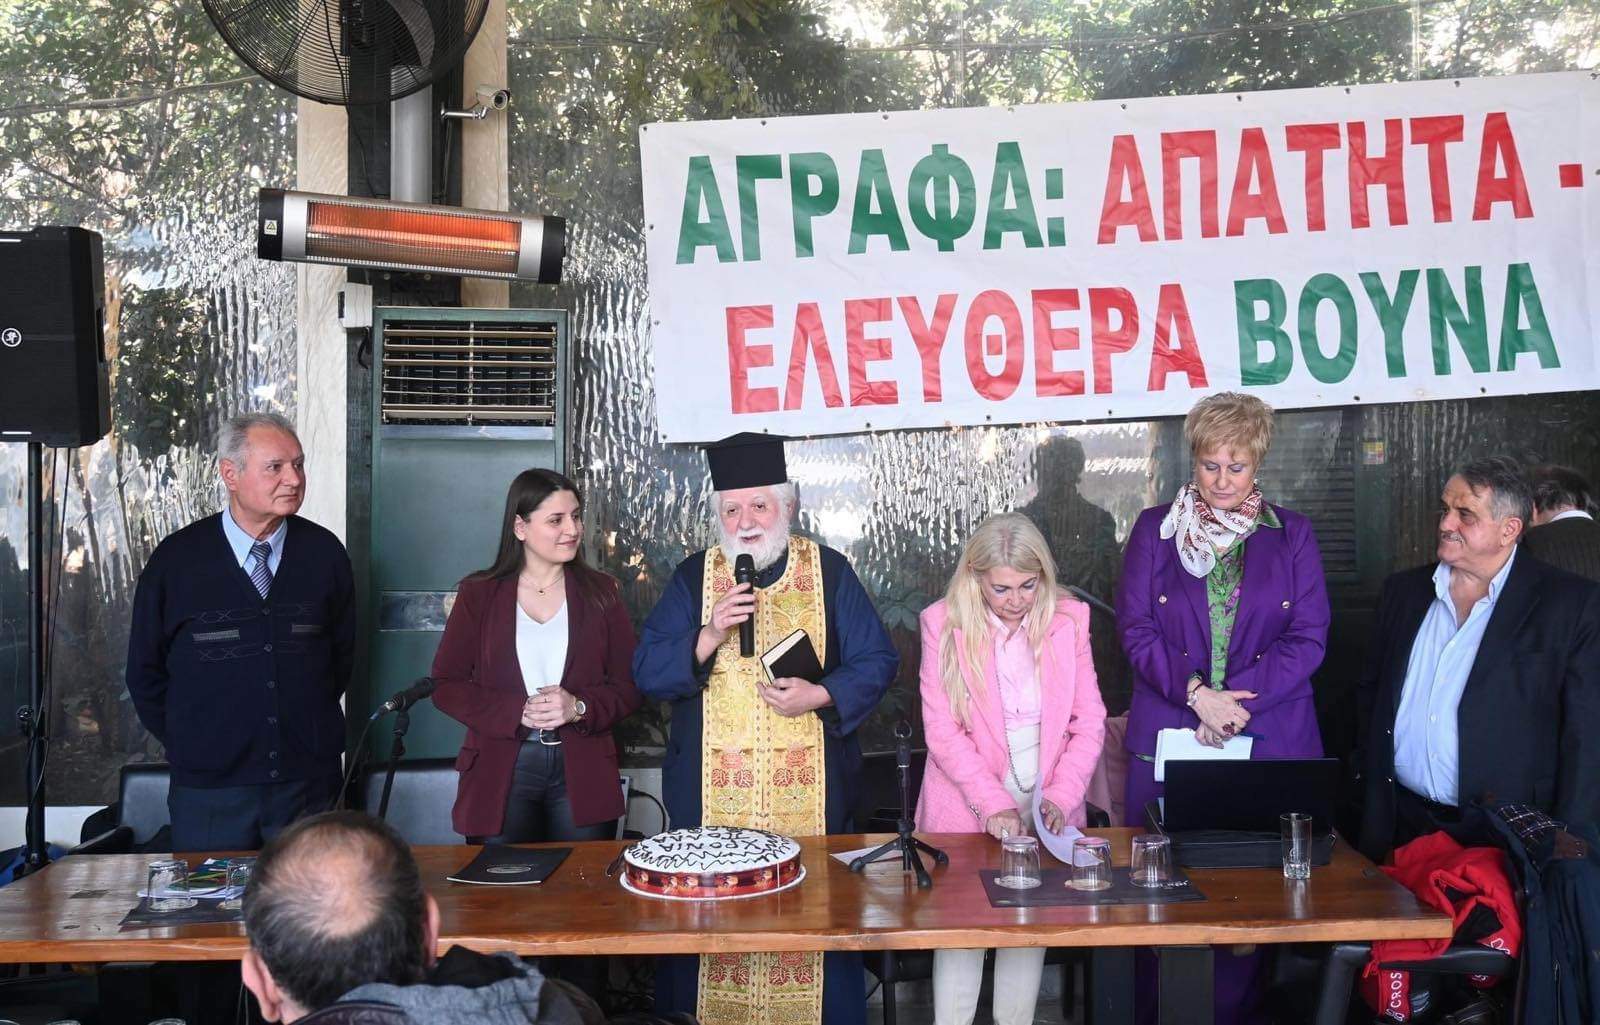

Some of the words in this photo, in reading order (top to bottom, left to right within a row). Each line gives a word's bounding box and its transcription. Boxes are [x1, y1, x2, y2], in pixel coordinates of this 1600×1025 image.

[675, 141, 1067, 265] ΑΓΡΑΦΑ:
[1097, 111, 1534, 245] ΑΠΑΤΗΤΑ
[725, 283, 1209, 414] ΕΛΕΥΘΕΡΑ
[1233, 262, 1561, 387] ΒΟΥΝΑ
